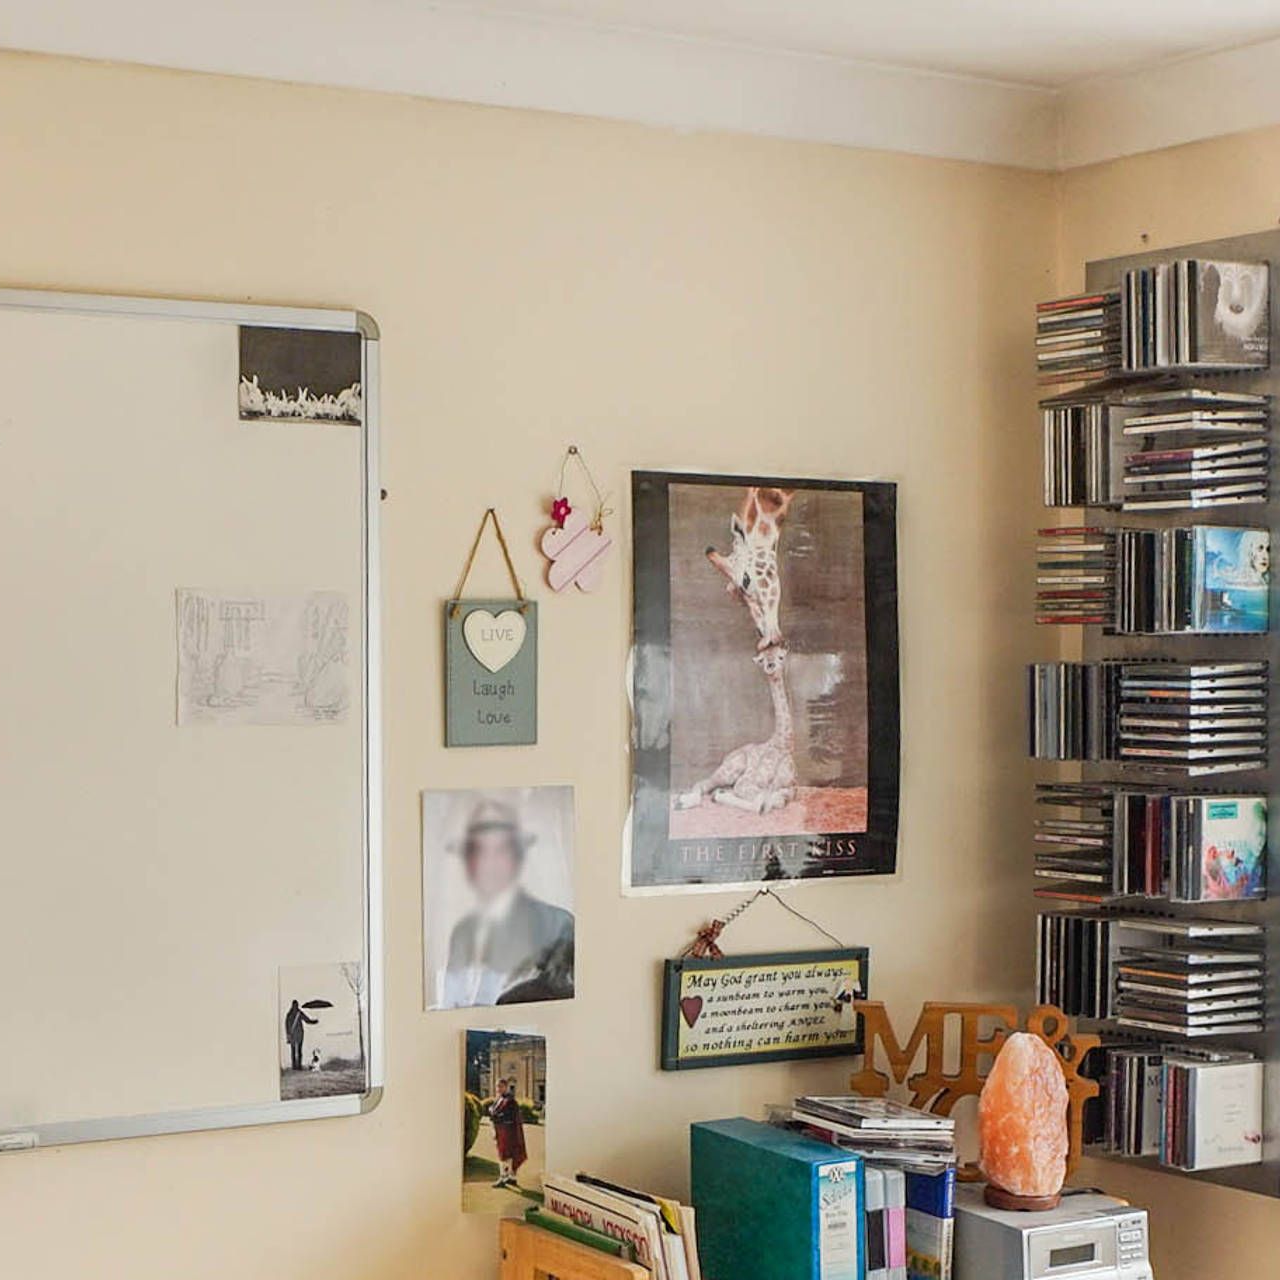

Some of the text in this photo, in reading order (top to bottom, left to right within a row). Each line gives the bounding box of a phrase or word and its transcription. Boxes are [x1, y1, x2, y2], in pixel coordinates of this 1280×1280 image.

[480, 628, 514, 641] LIVE
[473, 679, 515, 701] Laugh
[477, 709, 512, 724] Love
[681, 839, 856, 863] THE FIRST KISS
[686, 974, 717, 992] May
[720, 973, 742, 989] God
[744, 971, 778, 989] grant
[780, 970, 801, 985] you
[715, 991, 761, 1003] sunbeam
[764, 990, 775, 998] to
[777, 988, 806, 998] warm
[700, 1011, 707, 1019] a
[710, 1006, 764, 1018] moonbeam
[766, 1004, 778, 1014] to
[778, 1001, 810, 1012] charm
[704, 1016, 826, 1035] and a sheltering ANGEL
[685, 1029, 850, 1053] so nothing can harm you
